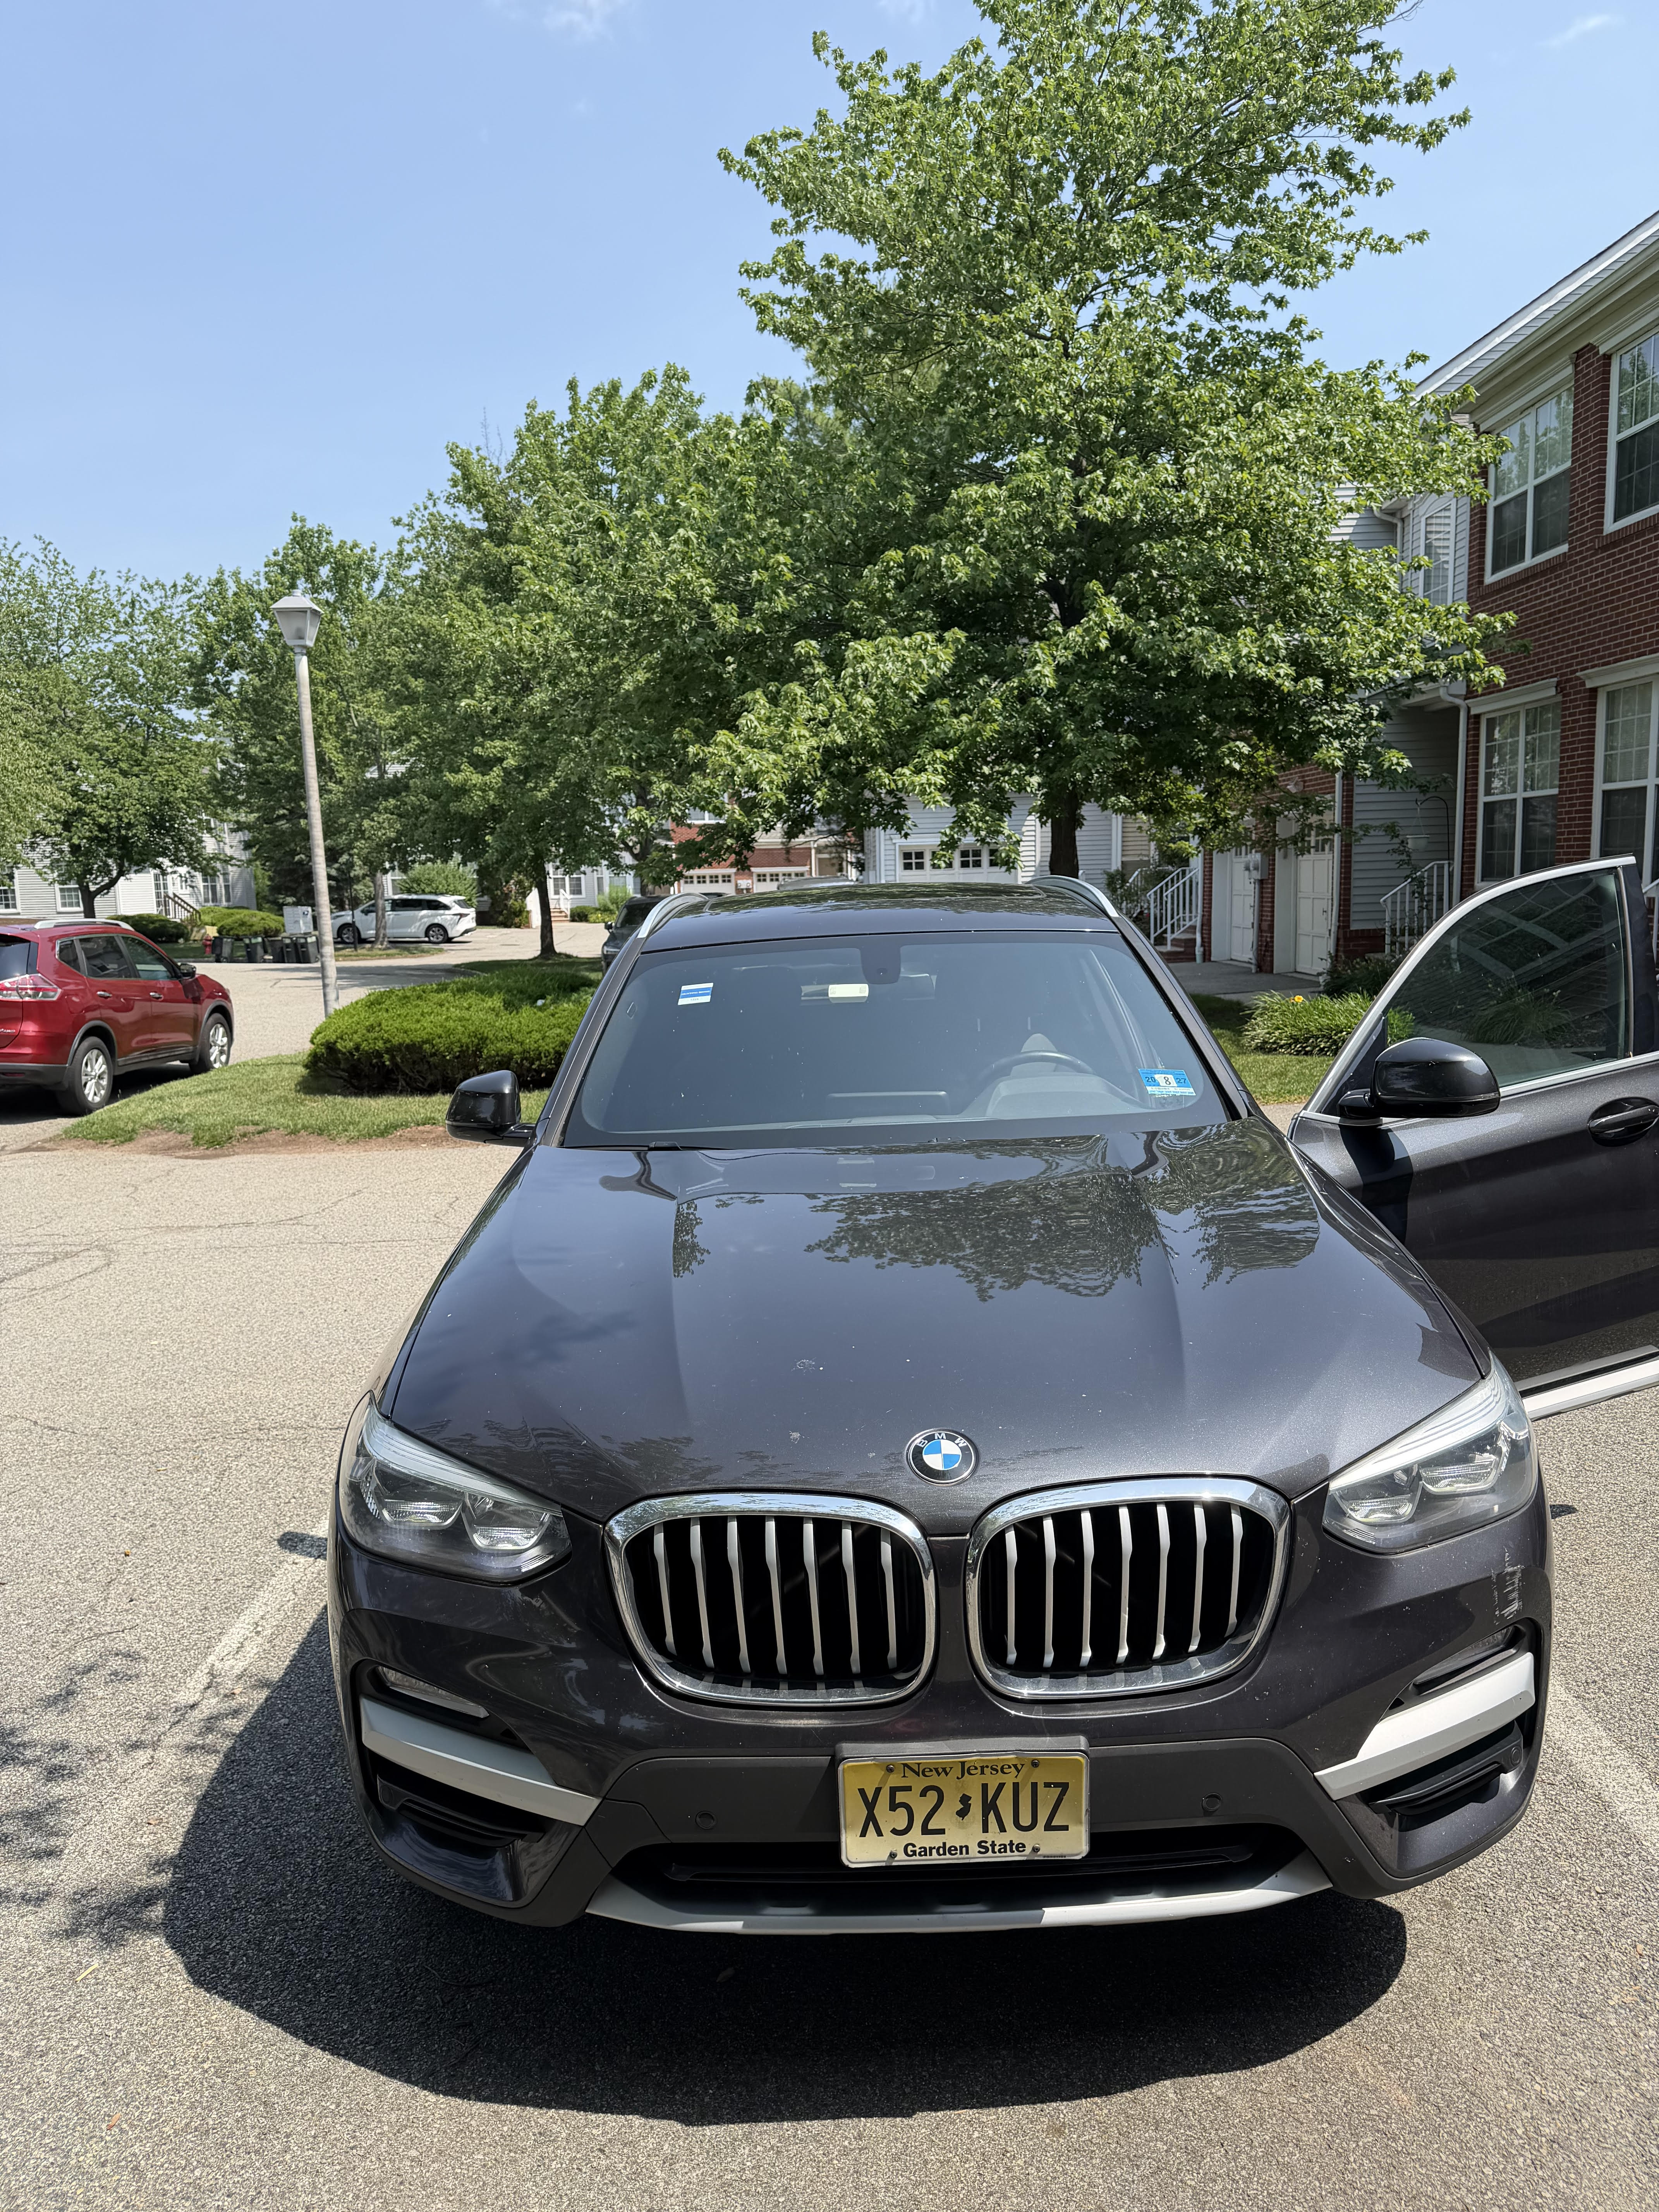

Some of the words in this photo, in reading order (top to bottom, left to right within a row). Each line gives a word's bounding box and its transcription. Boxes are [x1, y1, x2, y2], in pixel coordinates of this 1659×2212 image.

[1164, 1077, 1171, 1085] 8
[917, 1433, 967, 1448] BMW
[901, 1763, 953, 1778] New
[957, 1761, 1025, 1780] Jersey
[858, 1785, 946, 1837] X52
[981, 1782, 1069, 1833] KUZ
[903, 1842, 969, 1857] Garden
[977, 1840, 1026, 1854] State
